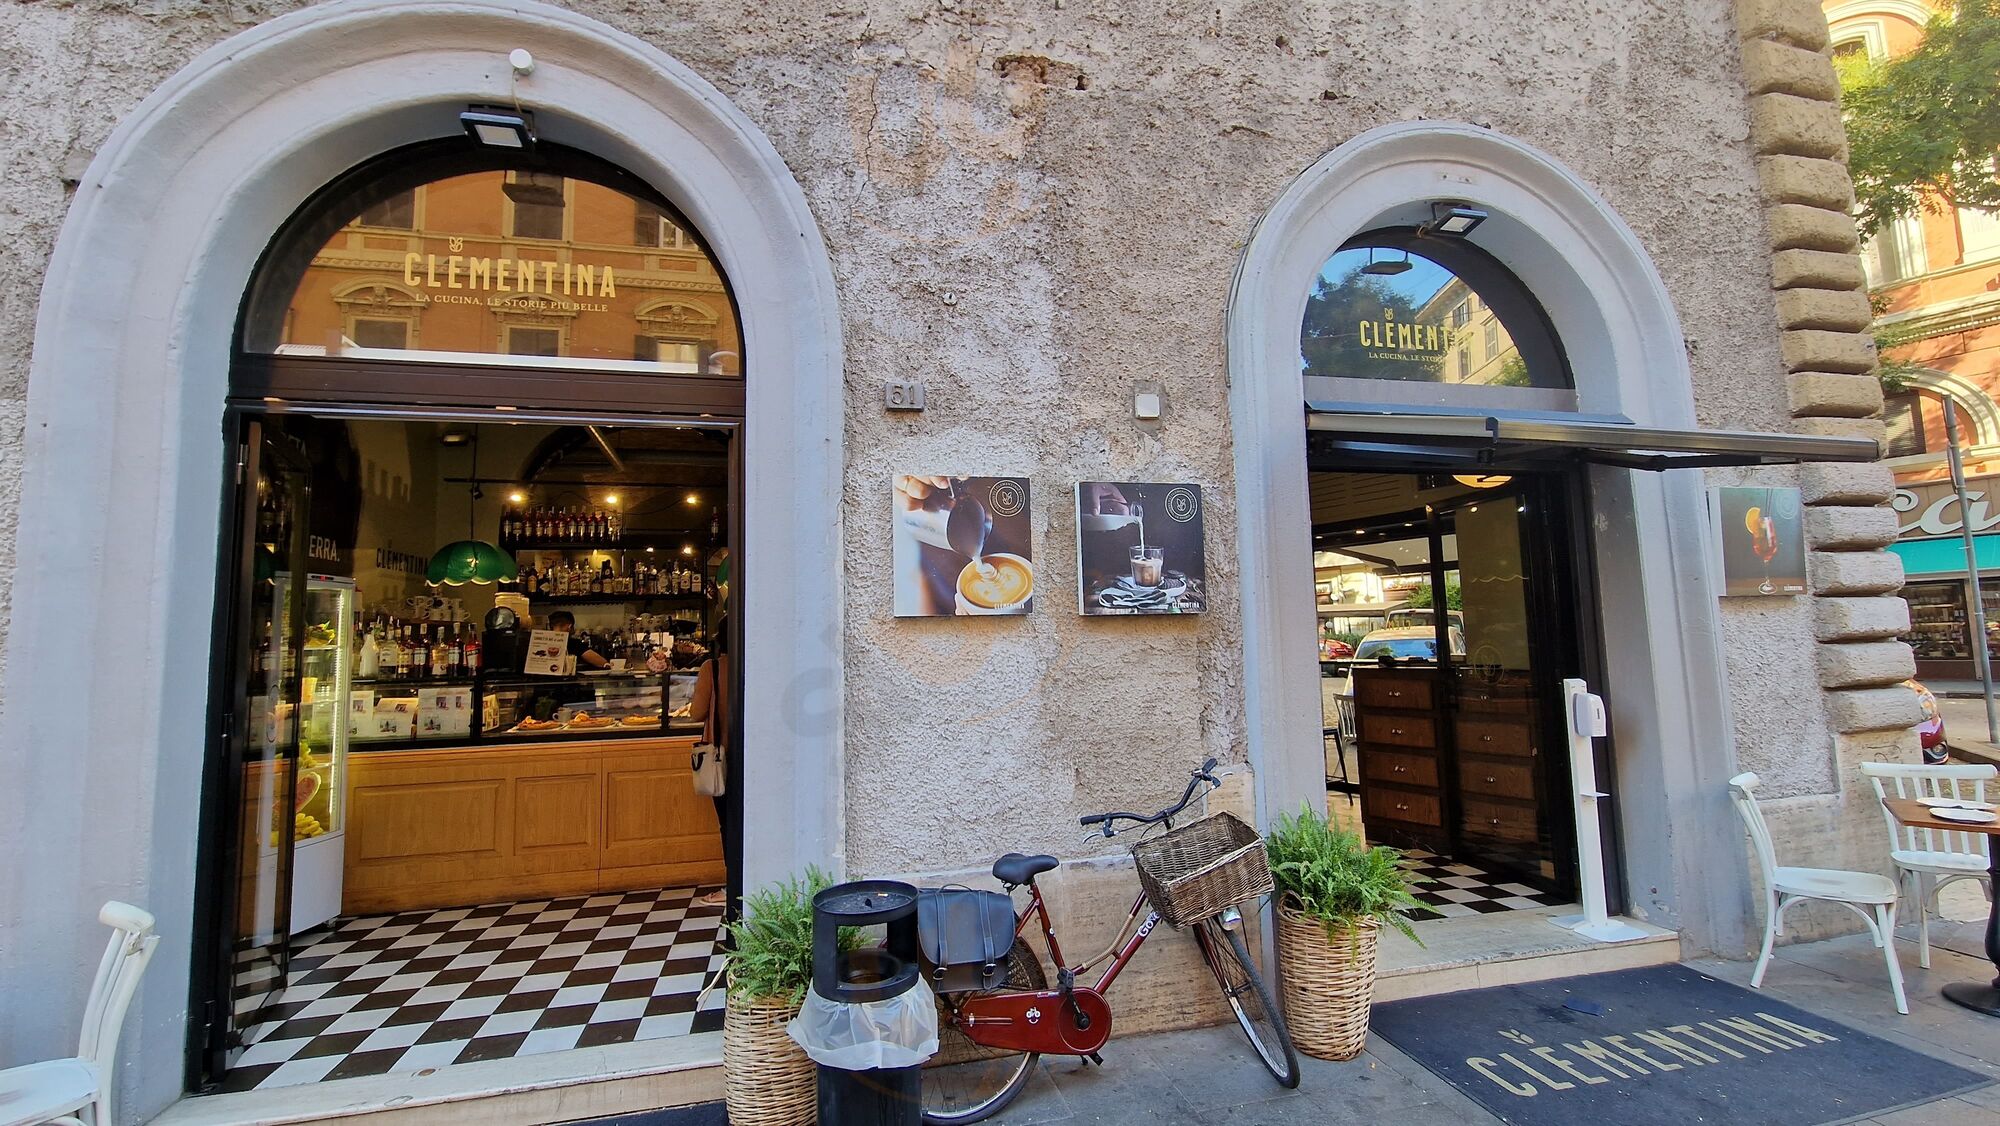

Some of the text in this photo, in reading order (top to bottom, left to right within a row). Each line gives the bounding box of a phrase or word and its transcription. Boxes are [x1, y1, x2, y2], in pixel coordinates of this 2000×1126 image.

[404, 252, 616, 298] CLEMENTINA
[416, 293, 431, 303] LA
[434, 294, 483, 306] CUCINA,
[487, 297, 502, 306] LE
[504, 298, 547, 309] STORIE
[573, 302, 608, 312] BELLE
[1360, 320, 1459, 351] CLEMENT
[891, 384, 915, 405] 51
[309, 535, 340, 562] ERRA.
[1466, 1012, 1840, 1097] CLEMENTINA
